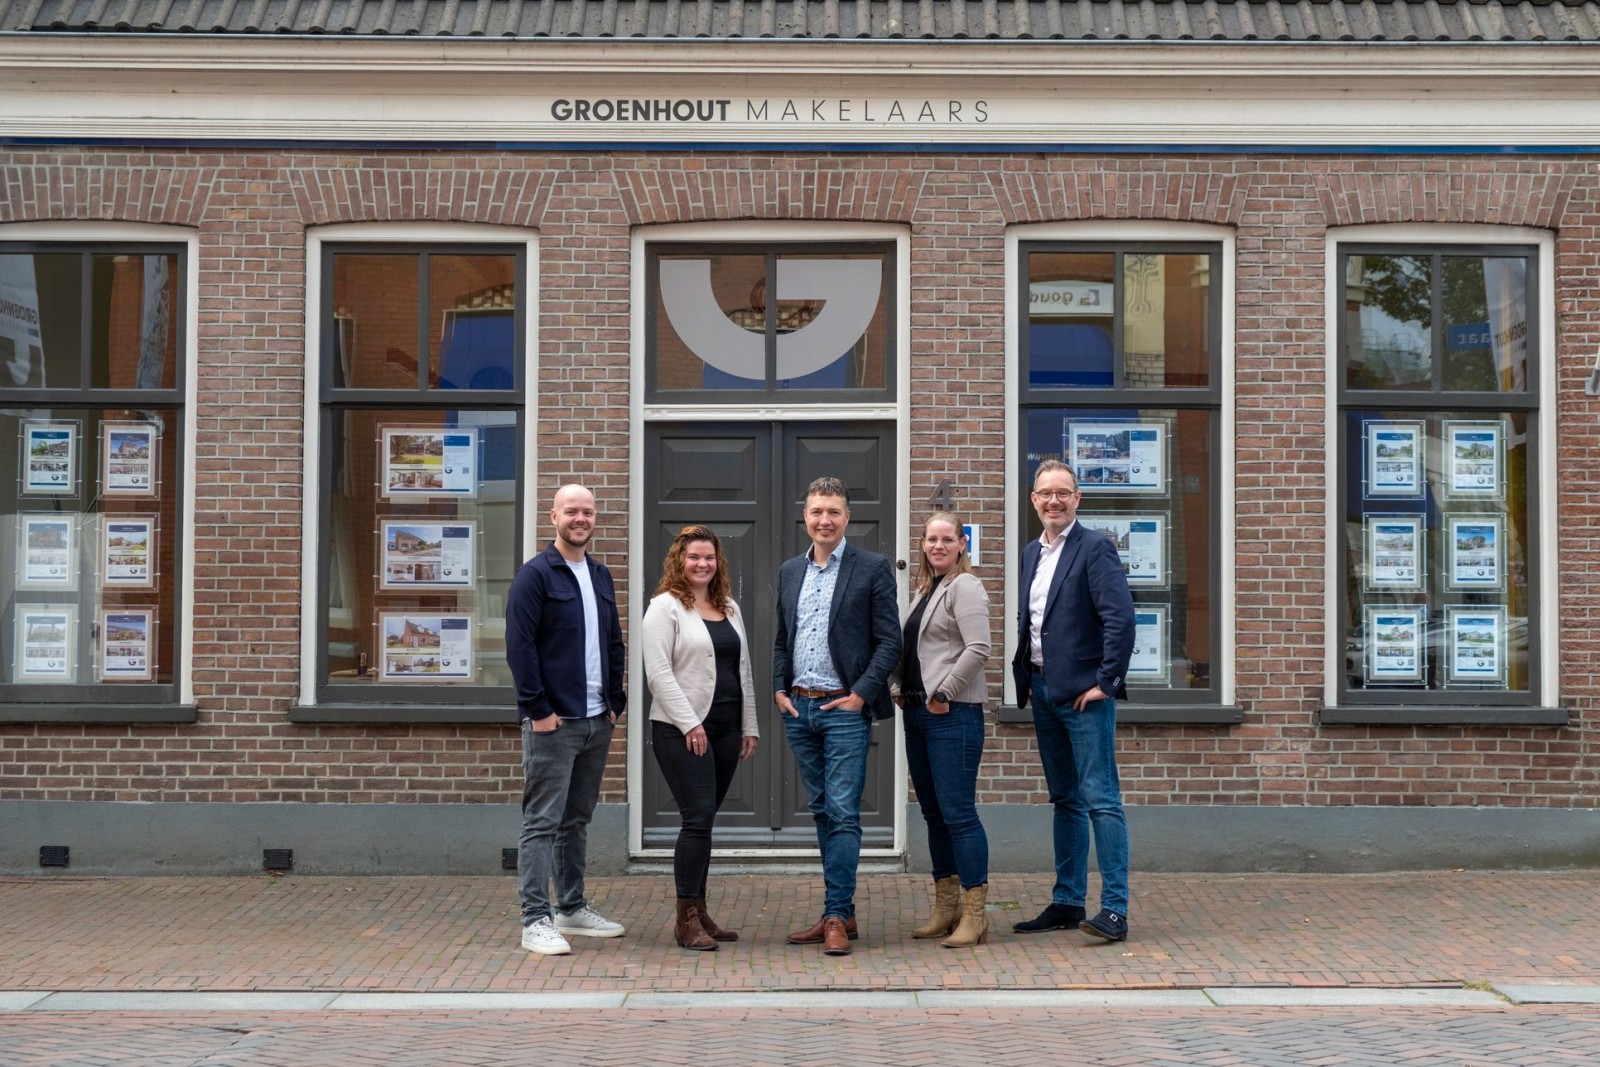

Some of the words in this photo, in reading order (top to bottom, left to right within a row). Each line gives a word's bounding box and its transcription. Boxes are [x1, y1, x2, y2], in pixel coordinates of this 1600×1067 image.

[550, 99, 731, 121] GROENHOUT
[746, 99, 989, 123] MAKELAARS
[929, 478, 957, 511] 4
